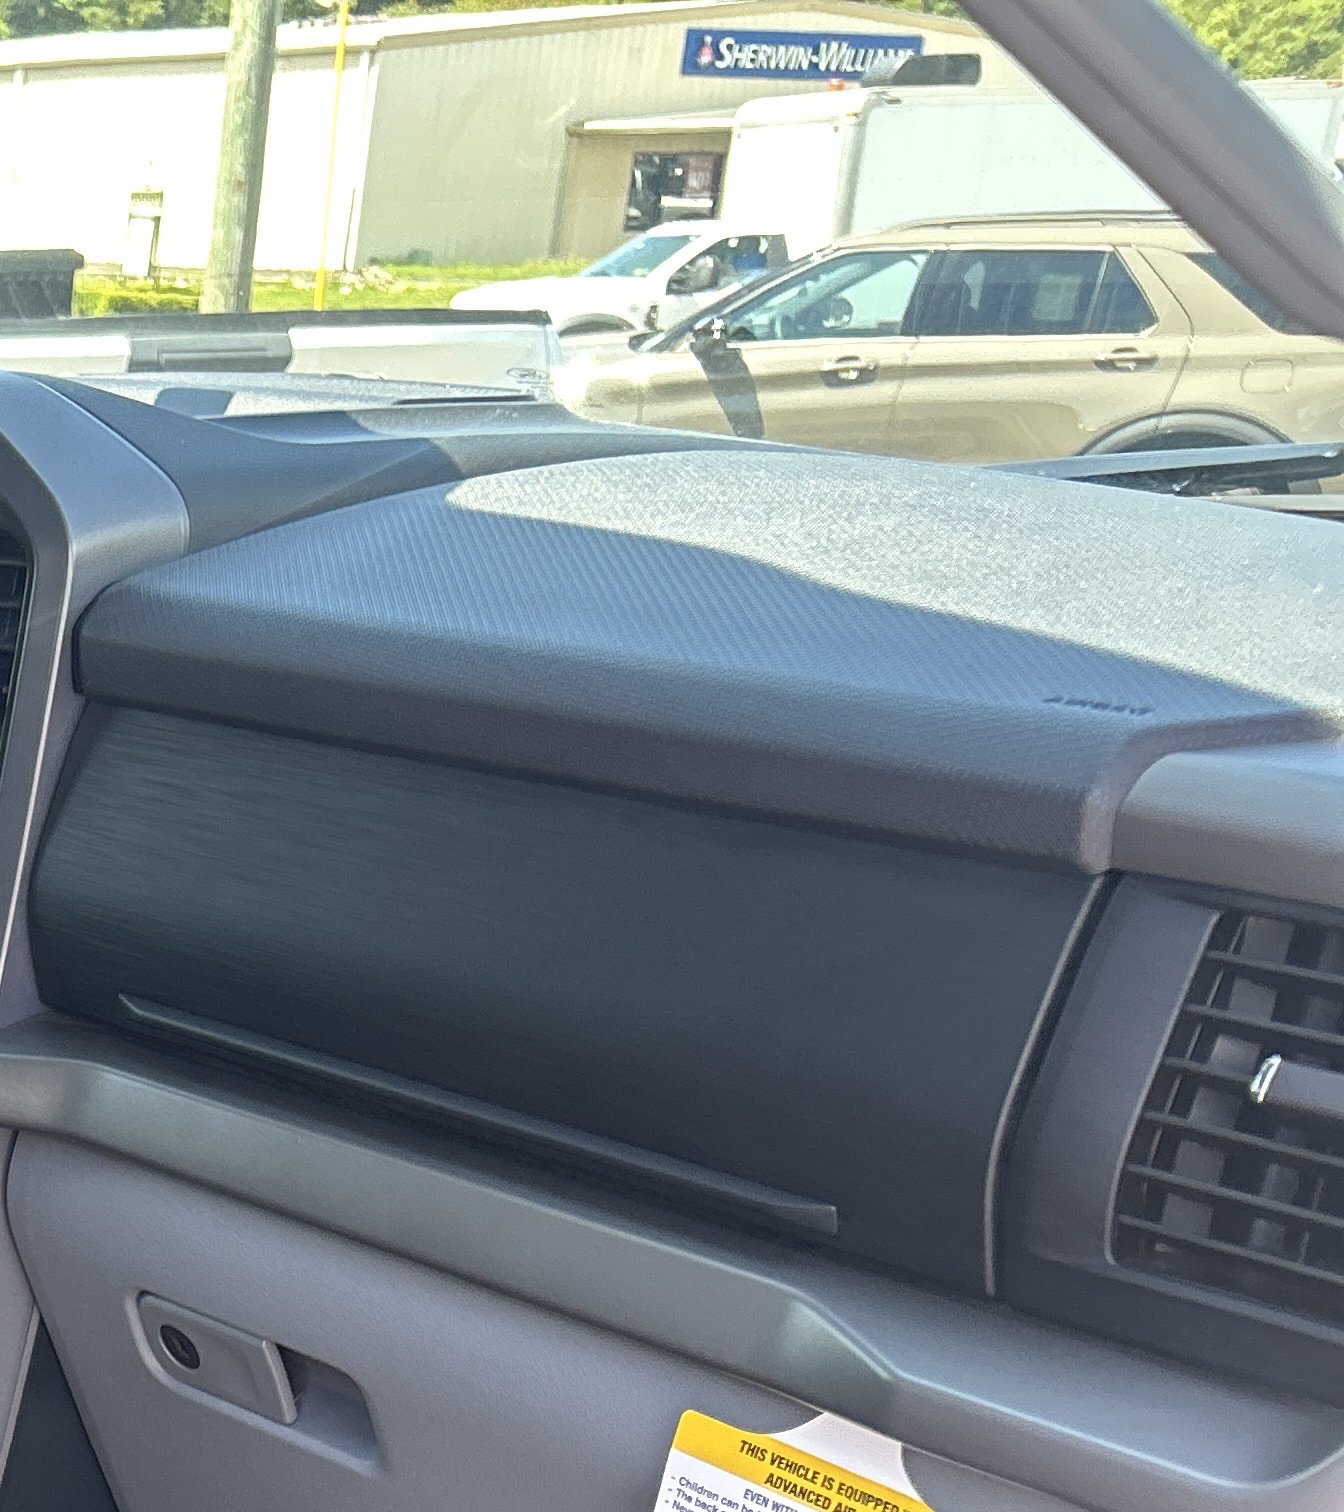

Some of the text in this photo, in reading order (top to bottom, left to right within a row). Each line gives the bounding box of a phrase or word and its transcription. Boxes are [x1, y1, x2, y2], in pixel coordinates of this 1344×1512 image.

[739, 1439, 768, 1462] THIS
[770, 1452, 821, 1485] VEHICLE
[821, 1475, 835, 1491] IS
[676, 1488, 692, 1503] The
[678, 1476, 719, 1500] Children
[721, 1497, 739, 1510] can
[743, 1488, 769, 1508] EVEN
[764, 1473, 831, 1510] ADVANCED
